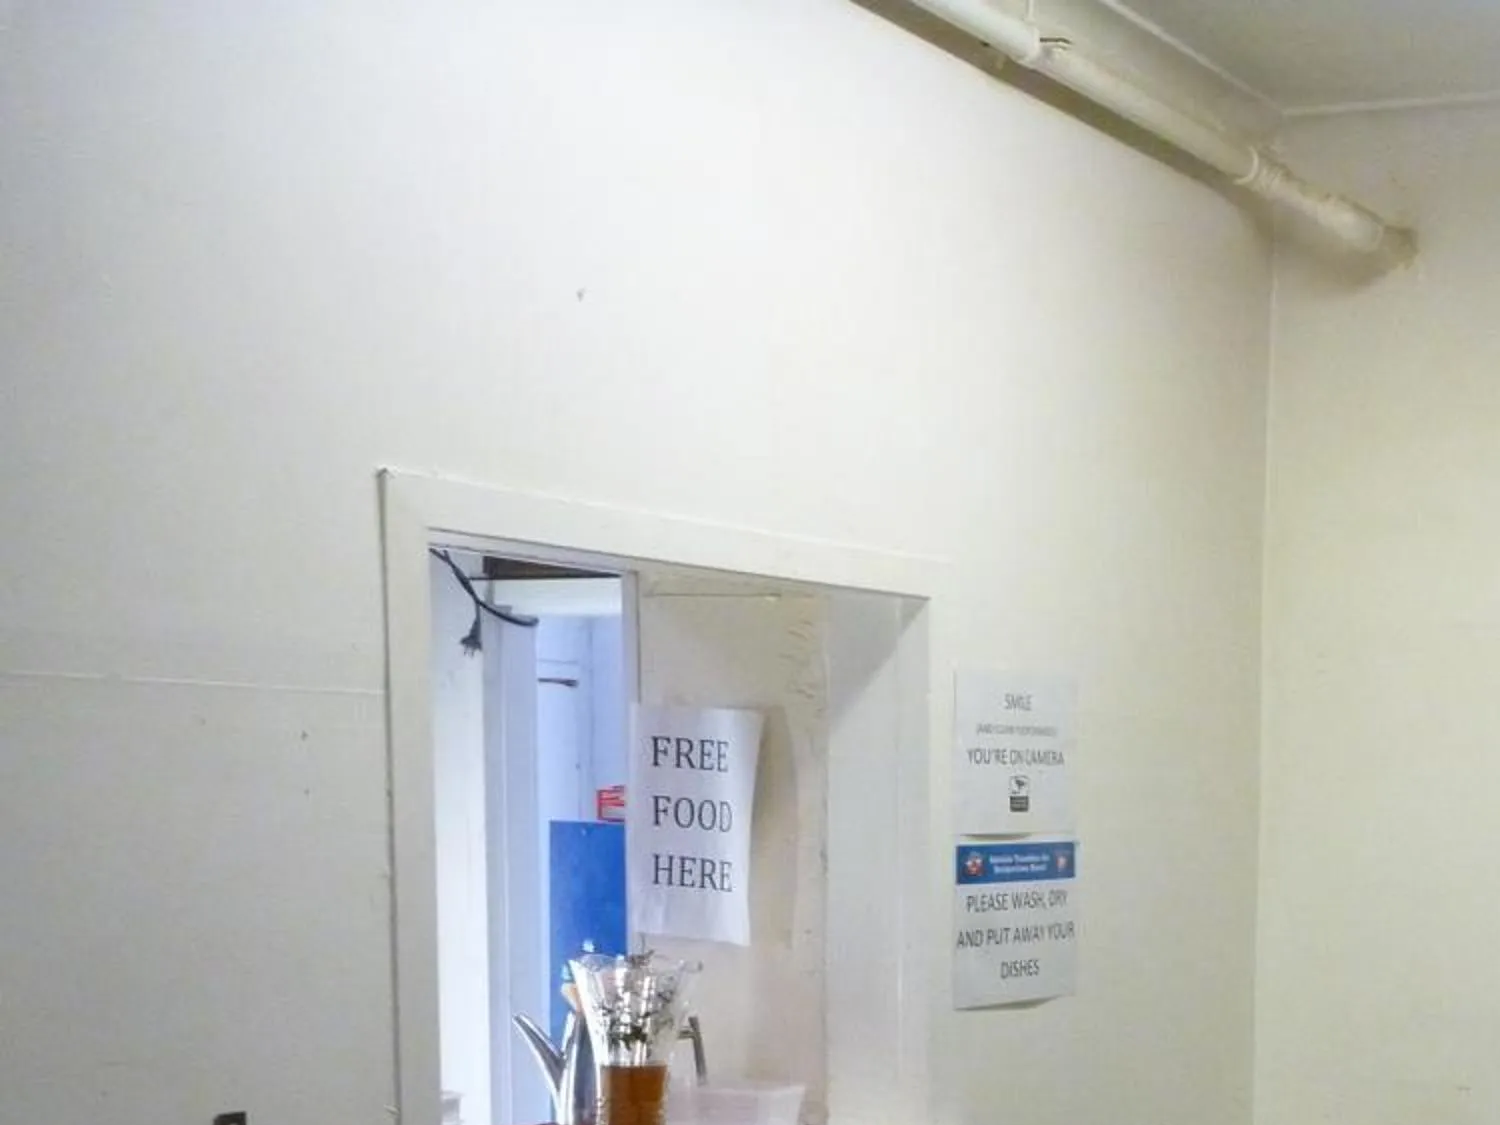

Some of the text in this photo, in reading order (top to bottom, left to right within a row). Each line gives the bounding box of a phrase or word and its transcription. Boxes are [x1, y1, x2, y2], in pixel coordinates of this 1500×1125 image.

[1004, 693, 1033, 711] SMILE
[651, 736, 730, 773] FREE
[967, 748, 1065, 766] YOU'RE ON CAMERA
[652, 795, 733, 833] FOOD
[652, 853, 733, 893] HERE
[965, 893, 1009, 913] PLEASE
[1048, 889, 1069, 907] DRY
[956, 920, 1076, 949] AND PUT AWAY YOUR
[999, 959, 1041, 980] DISHES
